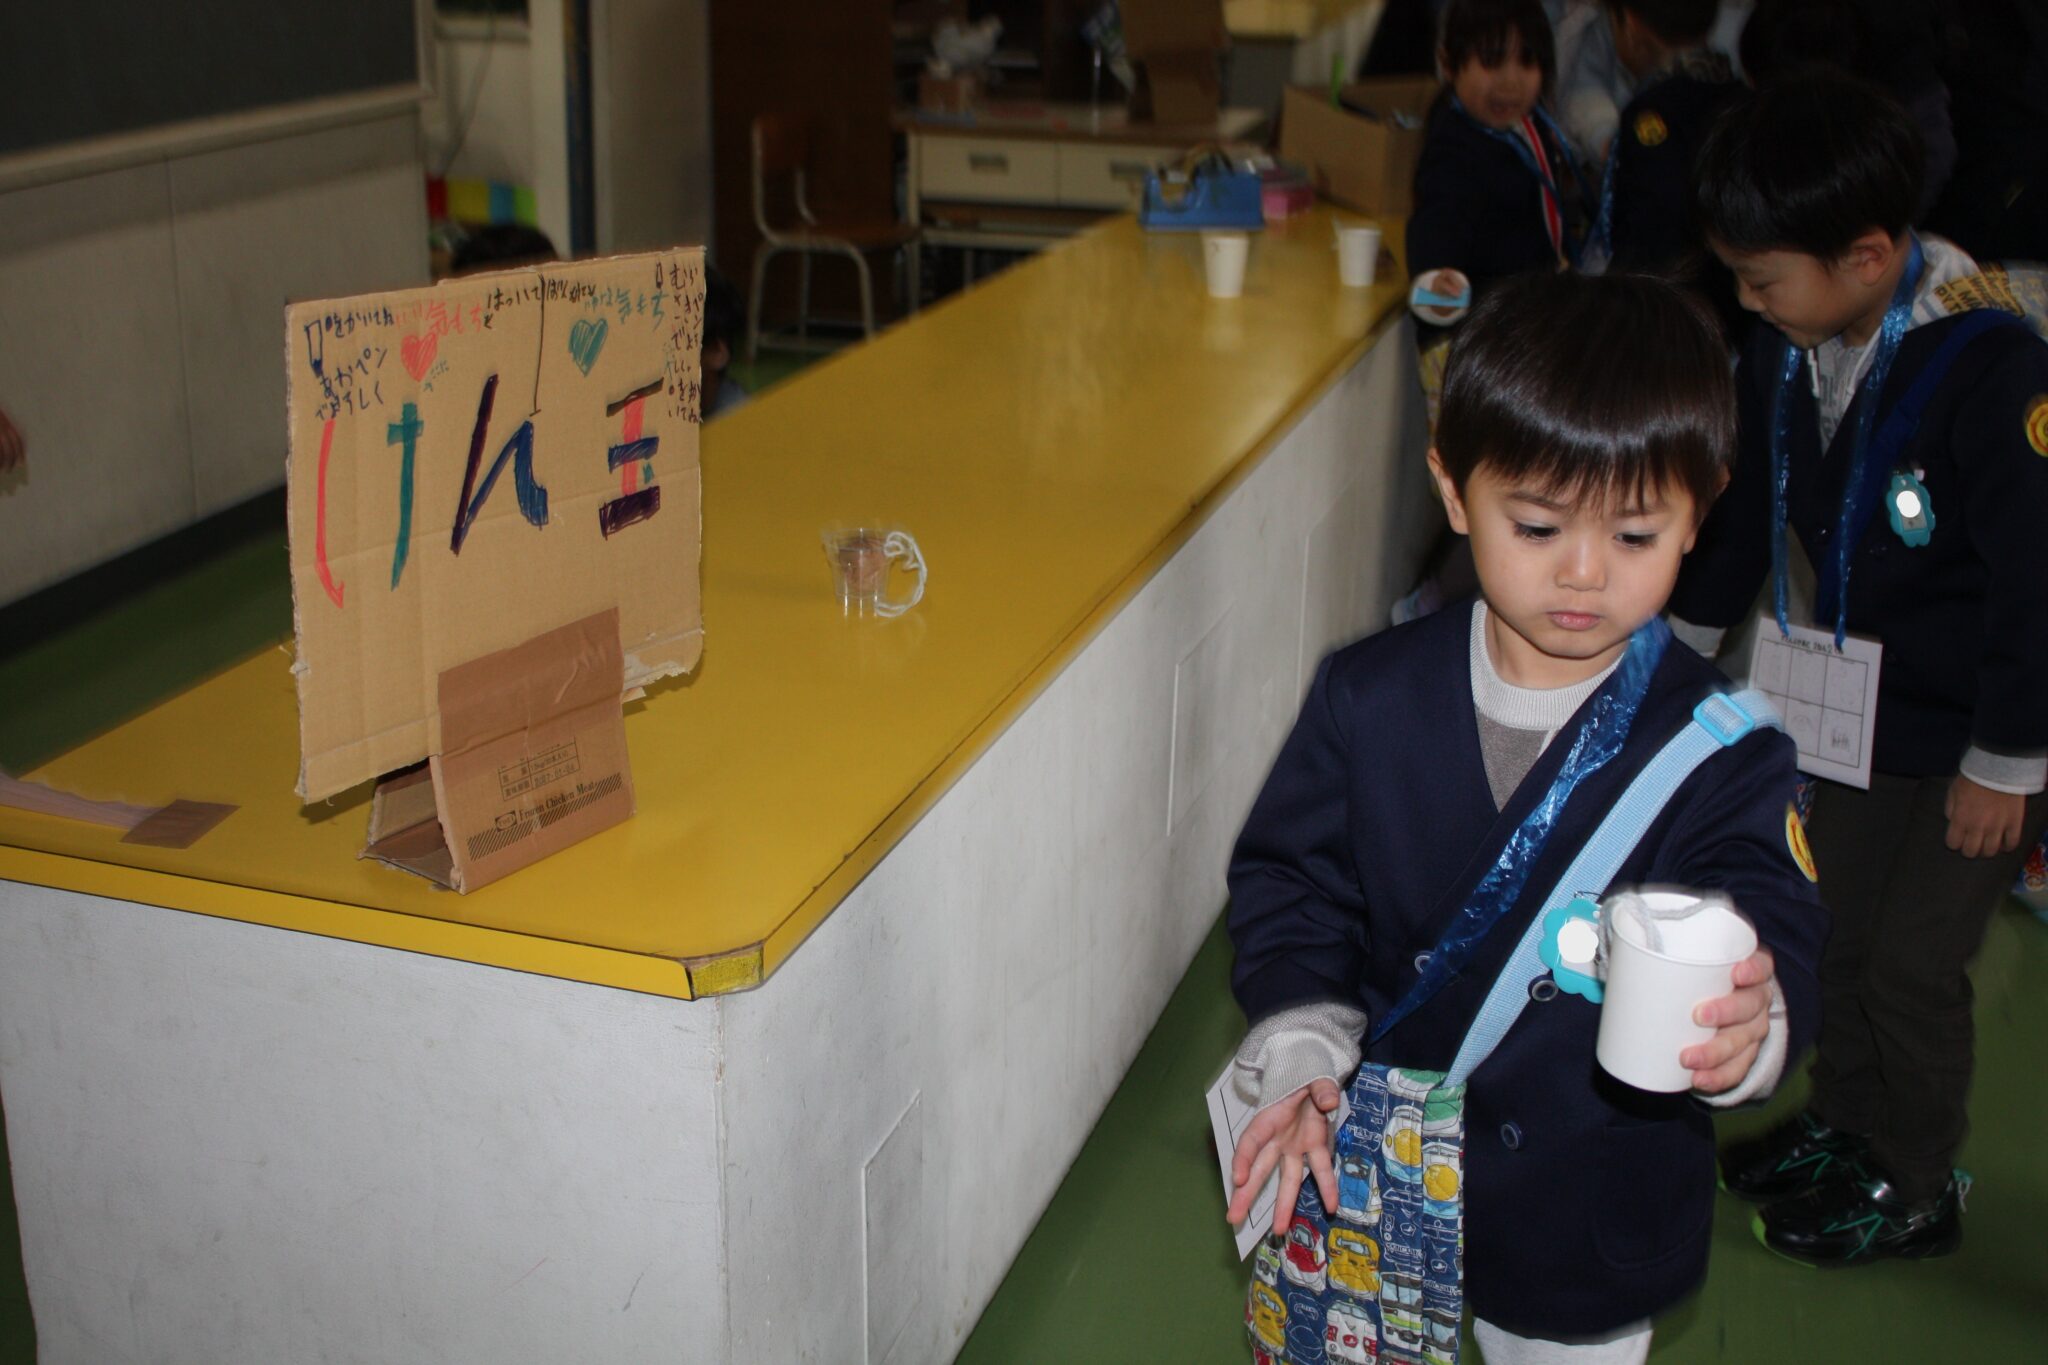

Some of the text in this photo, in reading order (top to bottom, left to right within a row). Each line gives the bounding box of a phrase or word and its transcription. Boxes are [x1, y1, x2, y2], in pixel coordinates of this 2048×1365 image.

[519, 803, 545, 821] Frozen
[545, 791, 575, 808] Chicken
[576, 781, 595, 795] Meat
